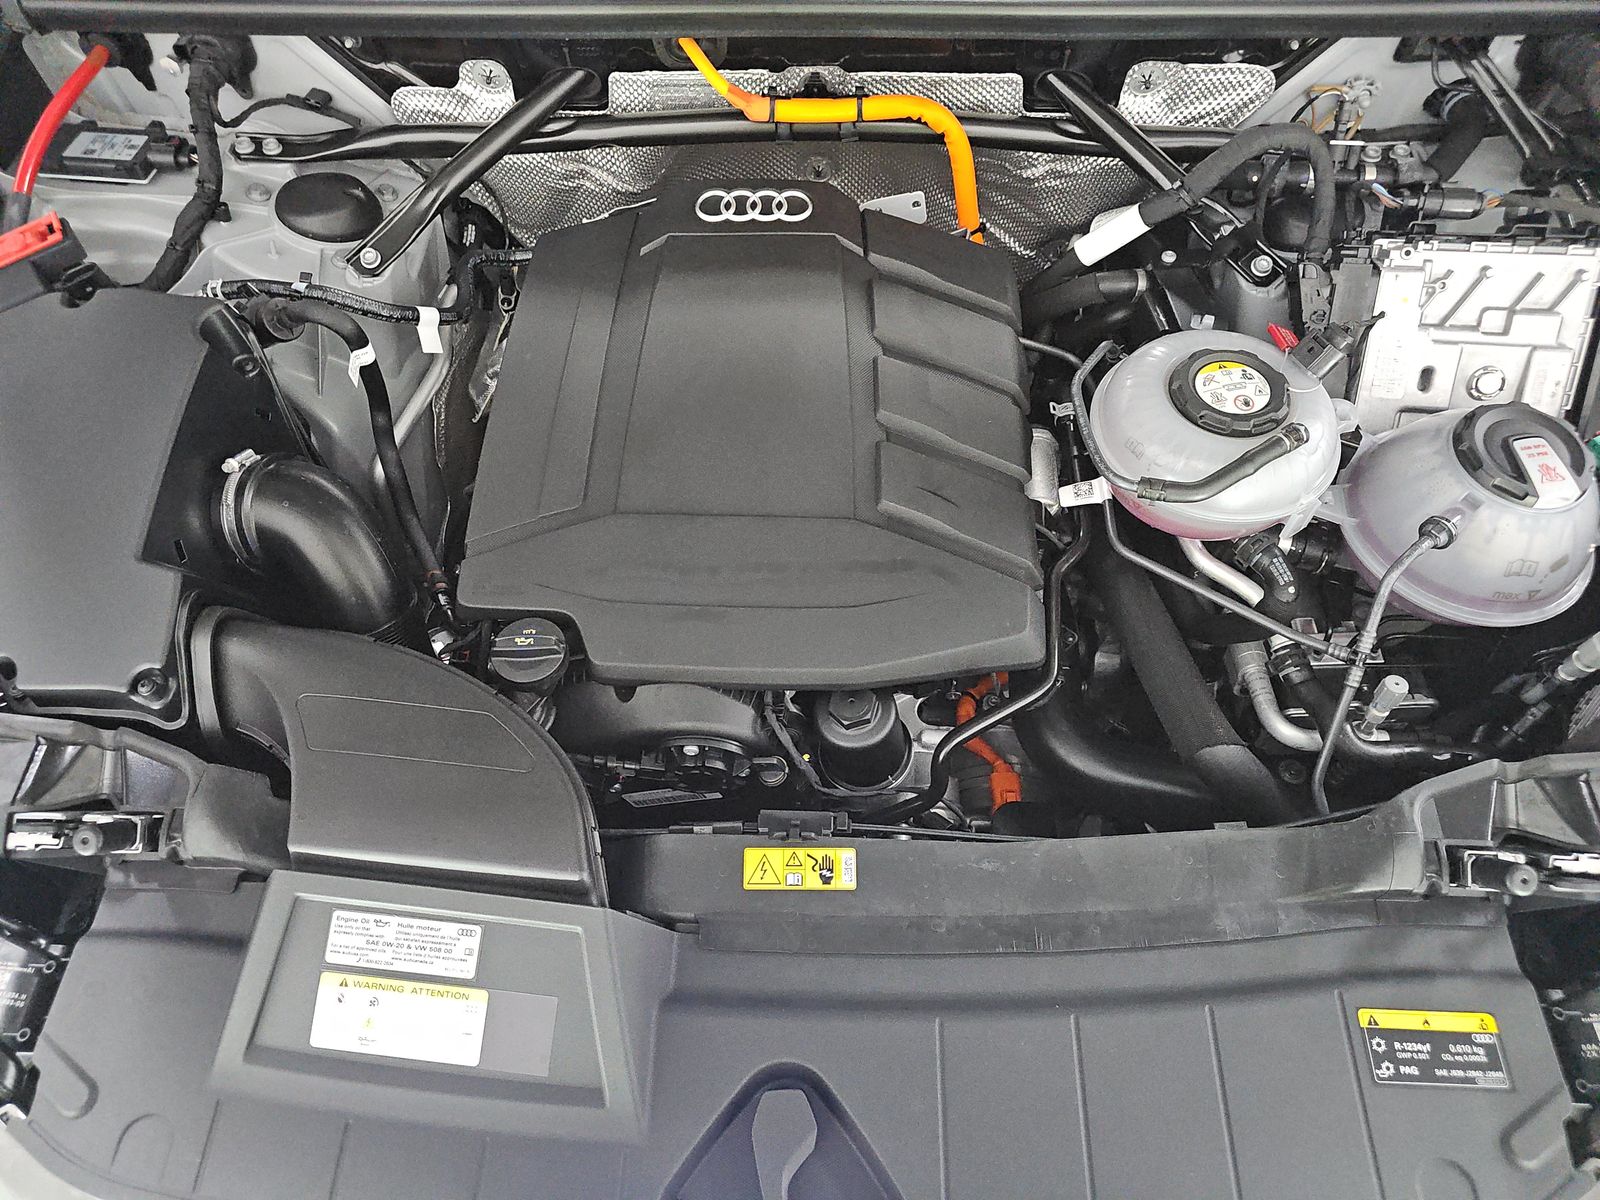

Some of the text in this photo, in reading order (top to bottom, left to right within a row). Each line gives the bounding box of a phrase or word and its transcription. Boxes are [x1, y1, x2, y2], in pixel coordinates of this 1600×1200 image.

[1492, 591, 1520, 600] max
[337, 915, 359, 923] Engine
[382, 941, 405, 949] 0W-20
[353, 980, 471, 1000] WARNING ATTENTION
[1393, 1041, 1431, 1053] R-1234yf
[1472, 1044, 1486, 1055] kg
[1396, 1051, 1413, 1059] GWP
[1399, 1065, 1420, 1075] PAG
[1434, 1068, 1449, 1077] SAE
